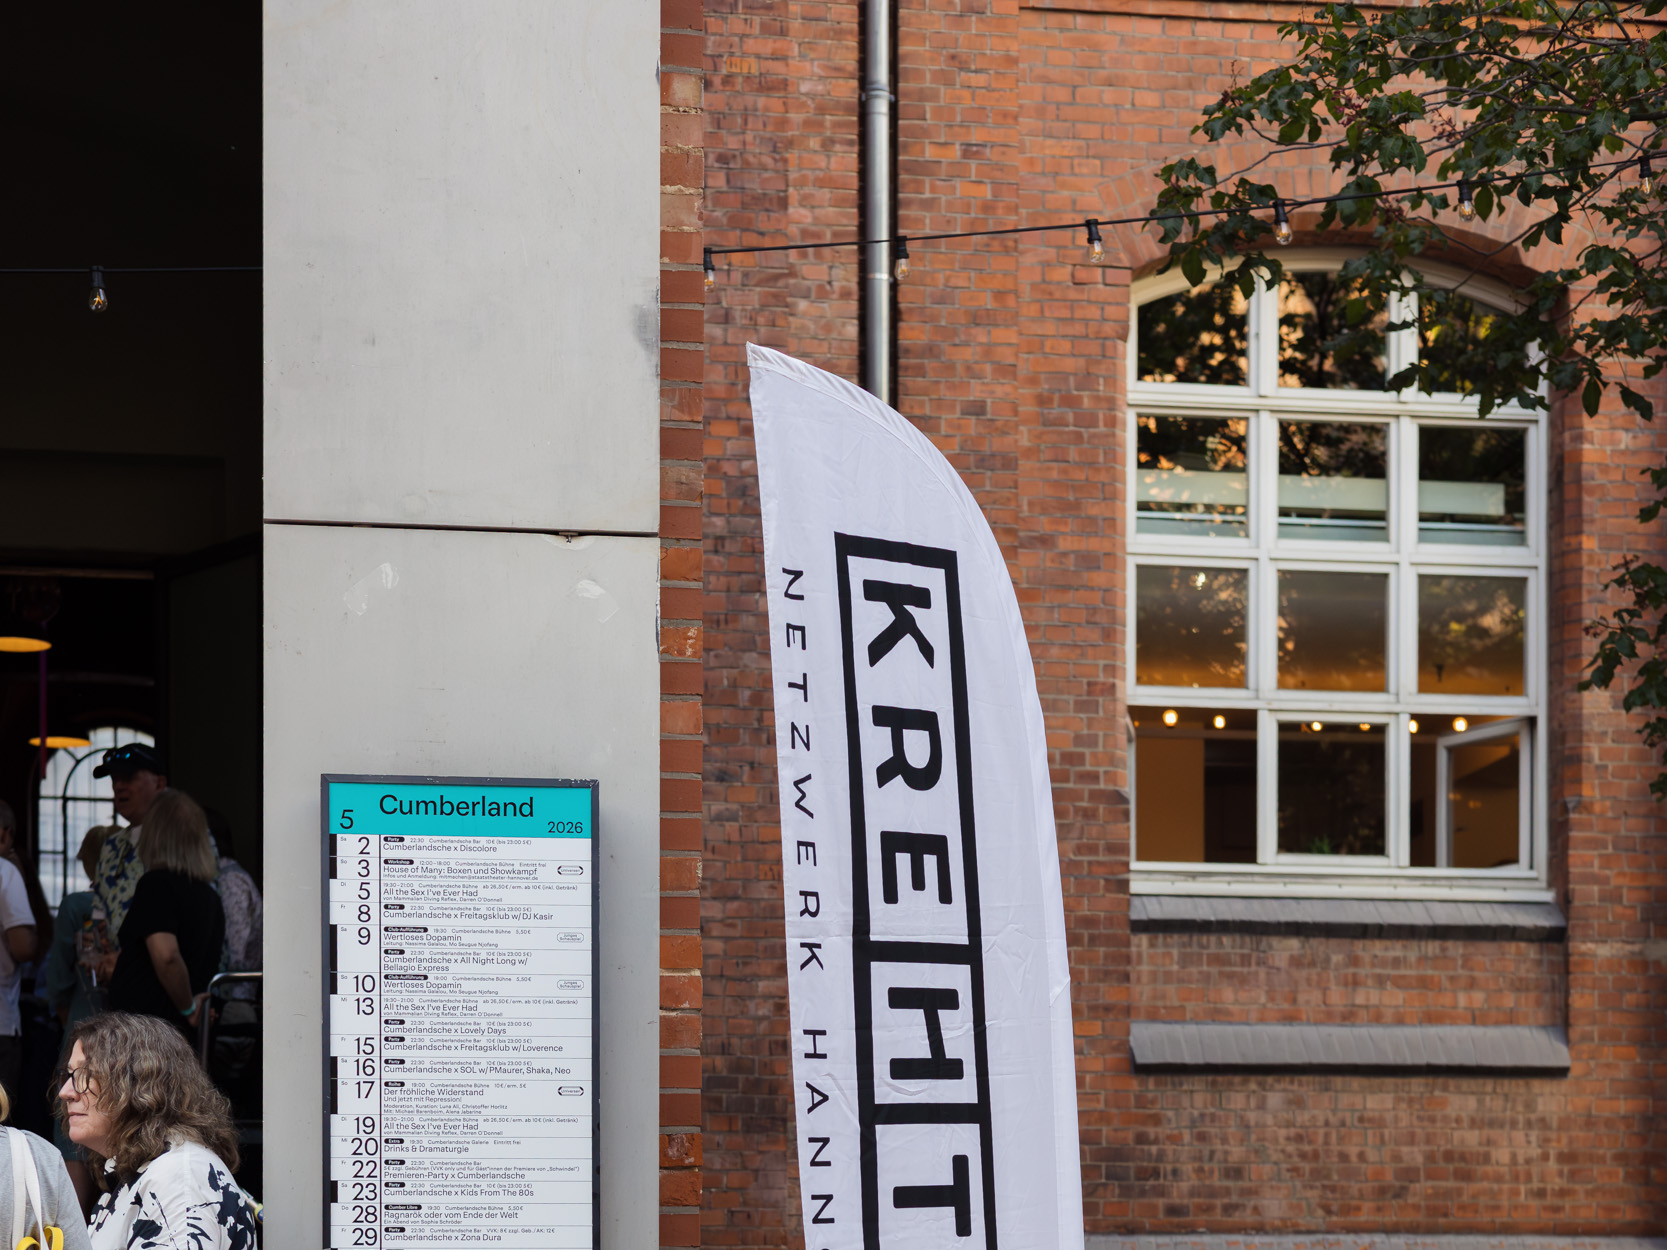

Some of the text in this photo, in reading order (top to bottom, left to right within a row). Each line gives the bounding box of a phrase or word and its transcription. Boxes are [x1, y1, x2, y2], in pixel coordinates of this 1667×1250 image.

[782, 567, 824, 971] NETZWERK
[380, 794, 533, 818] Cumberland
[340, 809, 354, 830] 5
[548, 821, 583, 834] 2026
[358, 836, 370, 855] 2
[383, 843, 452, 852] Cumberlandsche
[460, 844, 497, 853] Discolore
[358, 859, 370, 878] 3
[410, 865, 419, 874] of
[421, 866, 445, 875] Many:
[474, 867, 489, 875] und
[490, 867, 537, 876] Showkampf
[358, 882, 370, 900] 5
[395, 888, 409, 896] the
[410, 888, 425, 896] Sex
[443, 889, 460, 897] Ever
[357, 904, 371, 923] 8
[383, 911, 452, 919] Cumberlandsche
[460, 912, 510, 921] Freitagsklub
[511, 912, 521, 921] w/
[358, 927, 371, 945] 9
[383, 933, 462, 943] Wertloses Dopamin
[383, 955, 452, 964] Cumberlandsche
[472, 957, 494, 965] Night
[497, 958, 516, 966] Long
[518, 957, 528, 966] w/
[384, 964, 449, 972] Bellagio Express
[353, 974, 376, 993] 10
[384, 981, 462, 990] Wertloses Dopamin
[355, 997, 374, 1016] 13
[383, 1026, 452, 1034] Cumberlandsche
[460, 1026, 486, 1036] Lovely
[487, 1027, 506, 1036] Days
[355, 1037, 375, 1055] 15
[383, 1043, 452, 1051] Cumberlandsche
[460, 1043, 510, 1053] Freitagsklub
[512, 1044, 522, 1052] w/
[522, 1044, 563, 1052] Loverence
[354, 1058, 375, 1077] 16
[384, 1066, 452, 1074] Cumberlandsche
[460, 1066, 477, 1074] SOL
[478, 1066, 488, 1075] w/
[526, 1067, 553, 1075] Shaka,
[355, 1081, 375, 1099] 17
[400, 1088, 435, 1096] fröhliche
[437, 1088, 484, 1096] Widerstand
[354, 1116, 375, 1135] 19
[396, 1122, 409, 1130] the
[351, 1137, 378, 1156] 20
[419, 1145, 469, 1154] Dramaturgie
[352, 1160, 378, 1178] 22
[384, 1172, 449, 1180] Premieren-Party
[352, 1182, 377, 1201] 23
[502, 1189, 517, 1197] The
[518, 1189, 534, 1197] 80s
[352, 1205, 378, 1224] 28
[384, 1211, 422, 1220] Ragnarök
[424, 1211, 443, 1219] oder
[463, 1211, 483, 1219] Ende
[500, 1211, 518, 1219] Welt
[352, 1227, 377, 1246] 29
